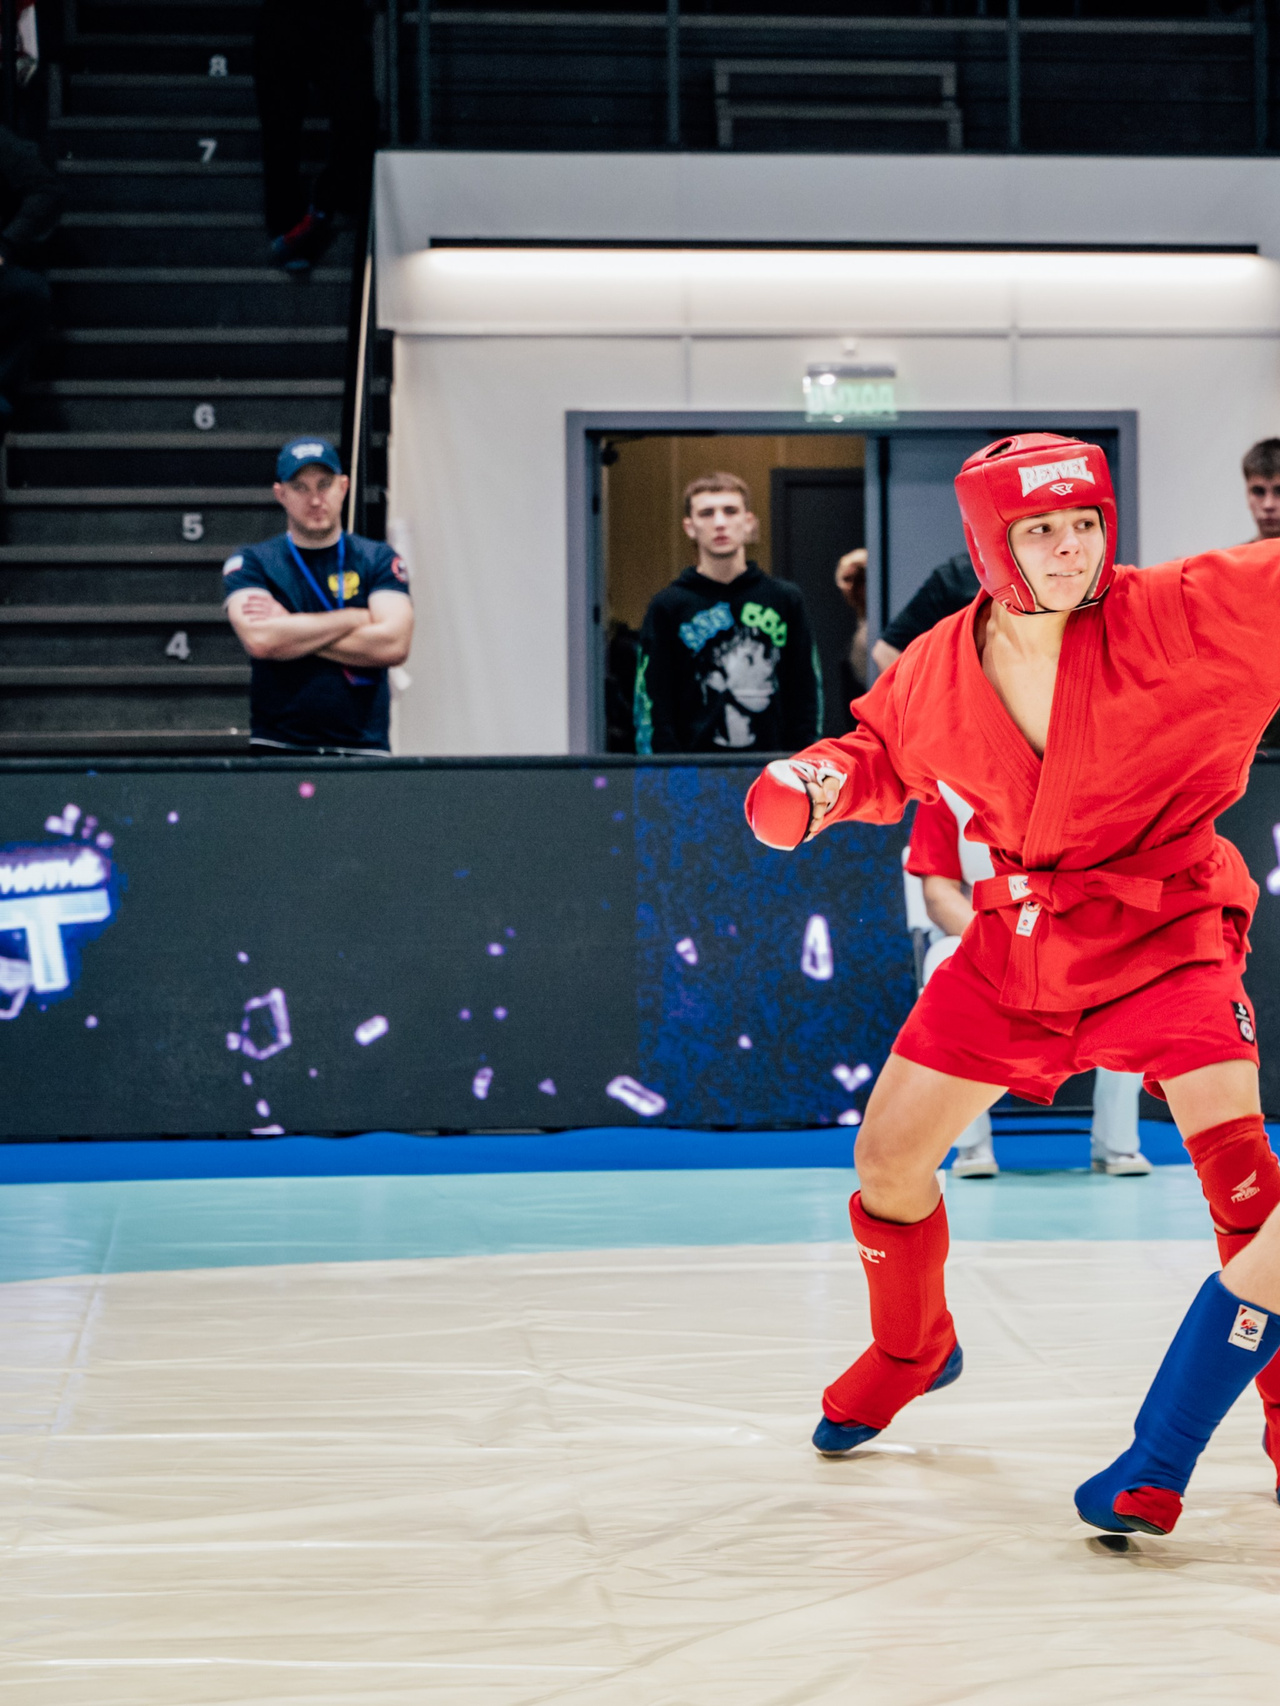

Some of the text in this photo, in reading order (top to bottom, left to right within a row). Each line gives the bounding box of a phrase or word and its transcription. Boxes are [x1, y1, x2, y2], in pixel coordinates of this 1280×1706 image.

[198, 138, 218, 162] 7
[193, 404, 215, 430] 6
[1018, 456, 1096, 498] REYVEL
[182, 512, 204, 541] 5
[165, 631, 191, 660] 4
